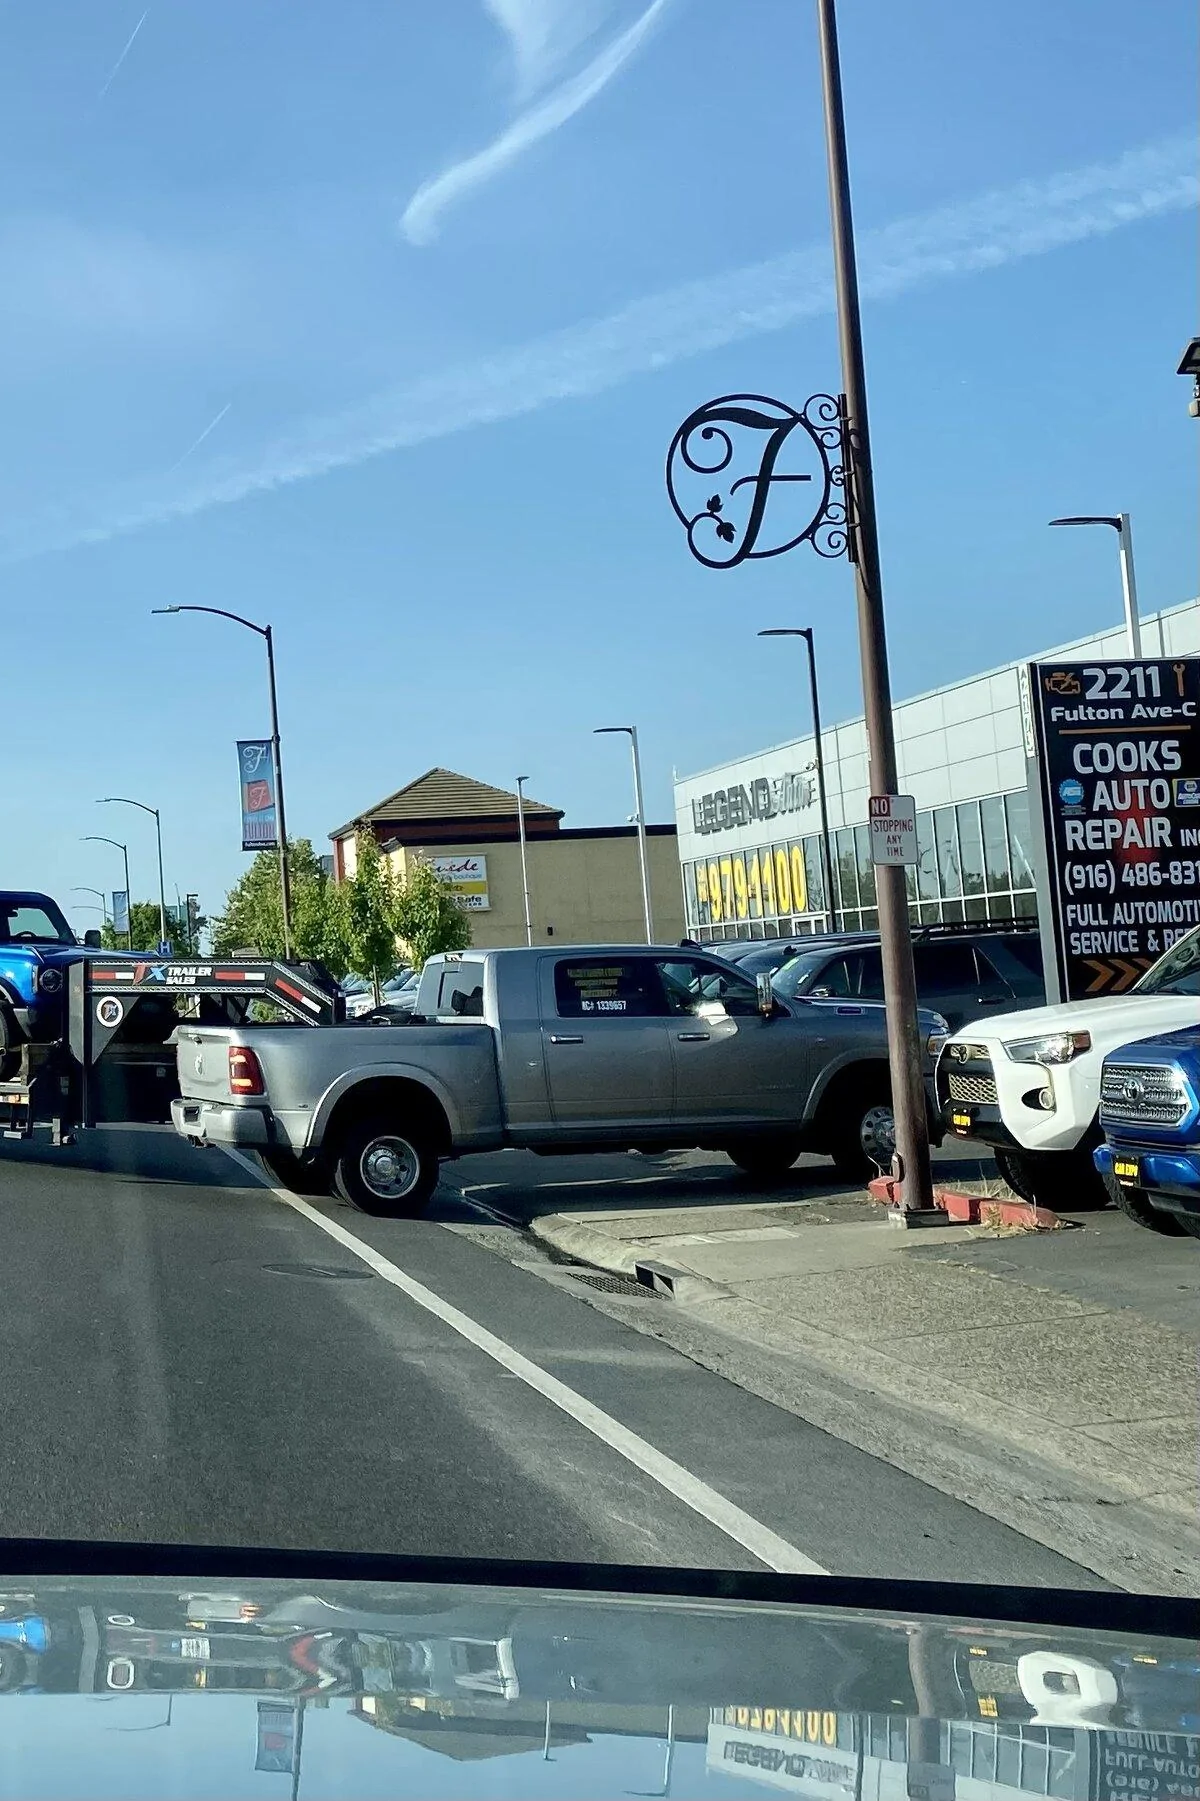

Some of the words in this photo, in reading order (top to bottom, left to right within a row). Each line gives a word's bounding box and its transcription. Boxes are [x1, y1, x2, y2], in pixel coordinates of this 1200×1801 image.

[1082, 665, 1161, 700] 2211
[1051, 704, 1124, 721] Fulton
[1131, 701, 1197, 719] Ave-C
[1073, 739, 1182, 774] COOKS
[871, 798, 888, 814] NO
[1092, 778, 1171, 812] AUTO
[873, 819, 914, 832] STOPPING
[1065, 817, 1173, 850] REPAIR
[886, 834, 902, 844] ANY
[886, 847, 904, 857] TIME
[708, 846, 807, 921] 979-1100
[1065, 860, 1116, 895] (916)
[1067, 903, 1109, 926] FULL
[1113, 900, 1200, 925] AUTOMOTI
[1070, 930, 1139, 954] SERVICE
[1147, 930, 1160, 951] &
[1164, 928, 1188, 950] RE
[166, 976, 196, 985] SALES
[167, 967, 213, 976] TRAILER
